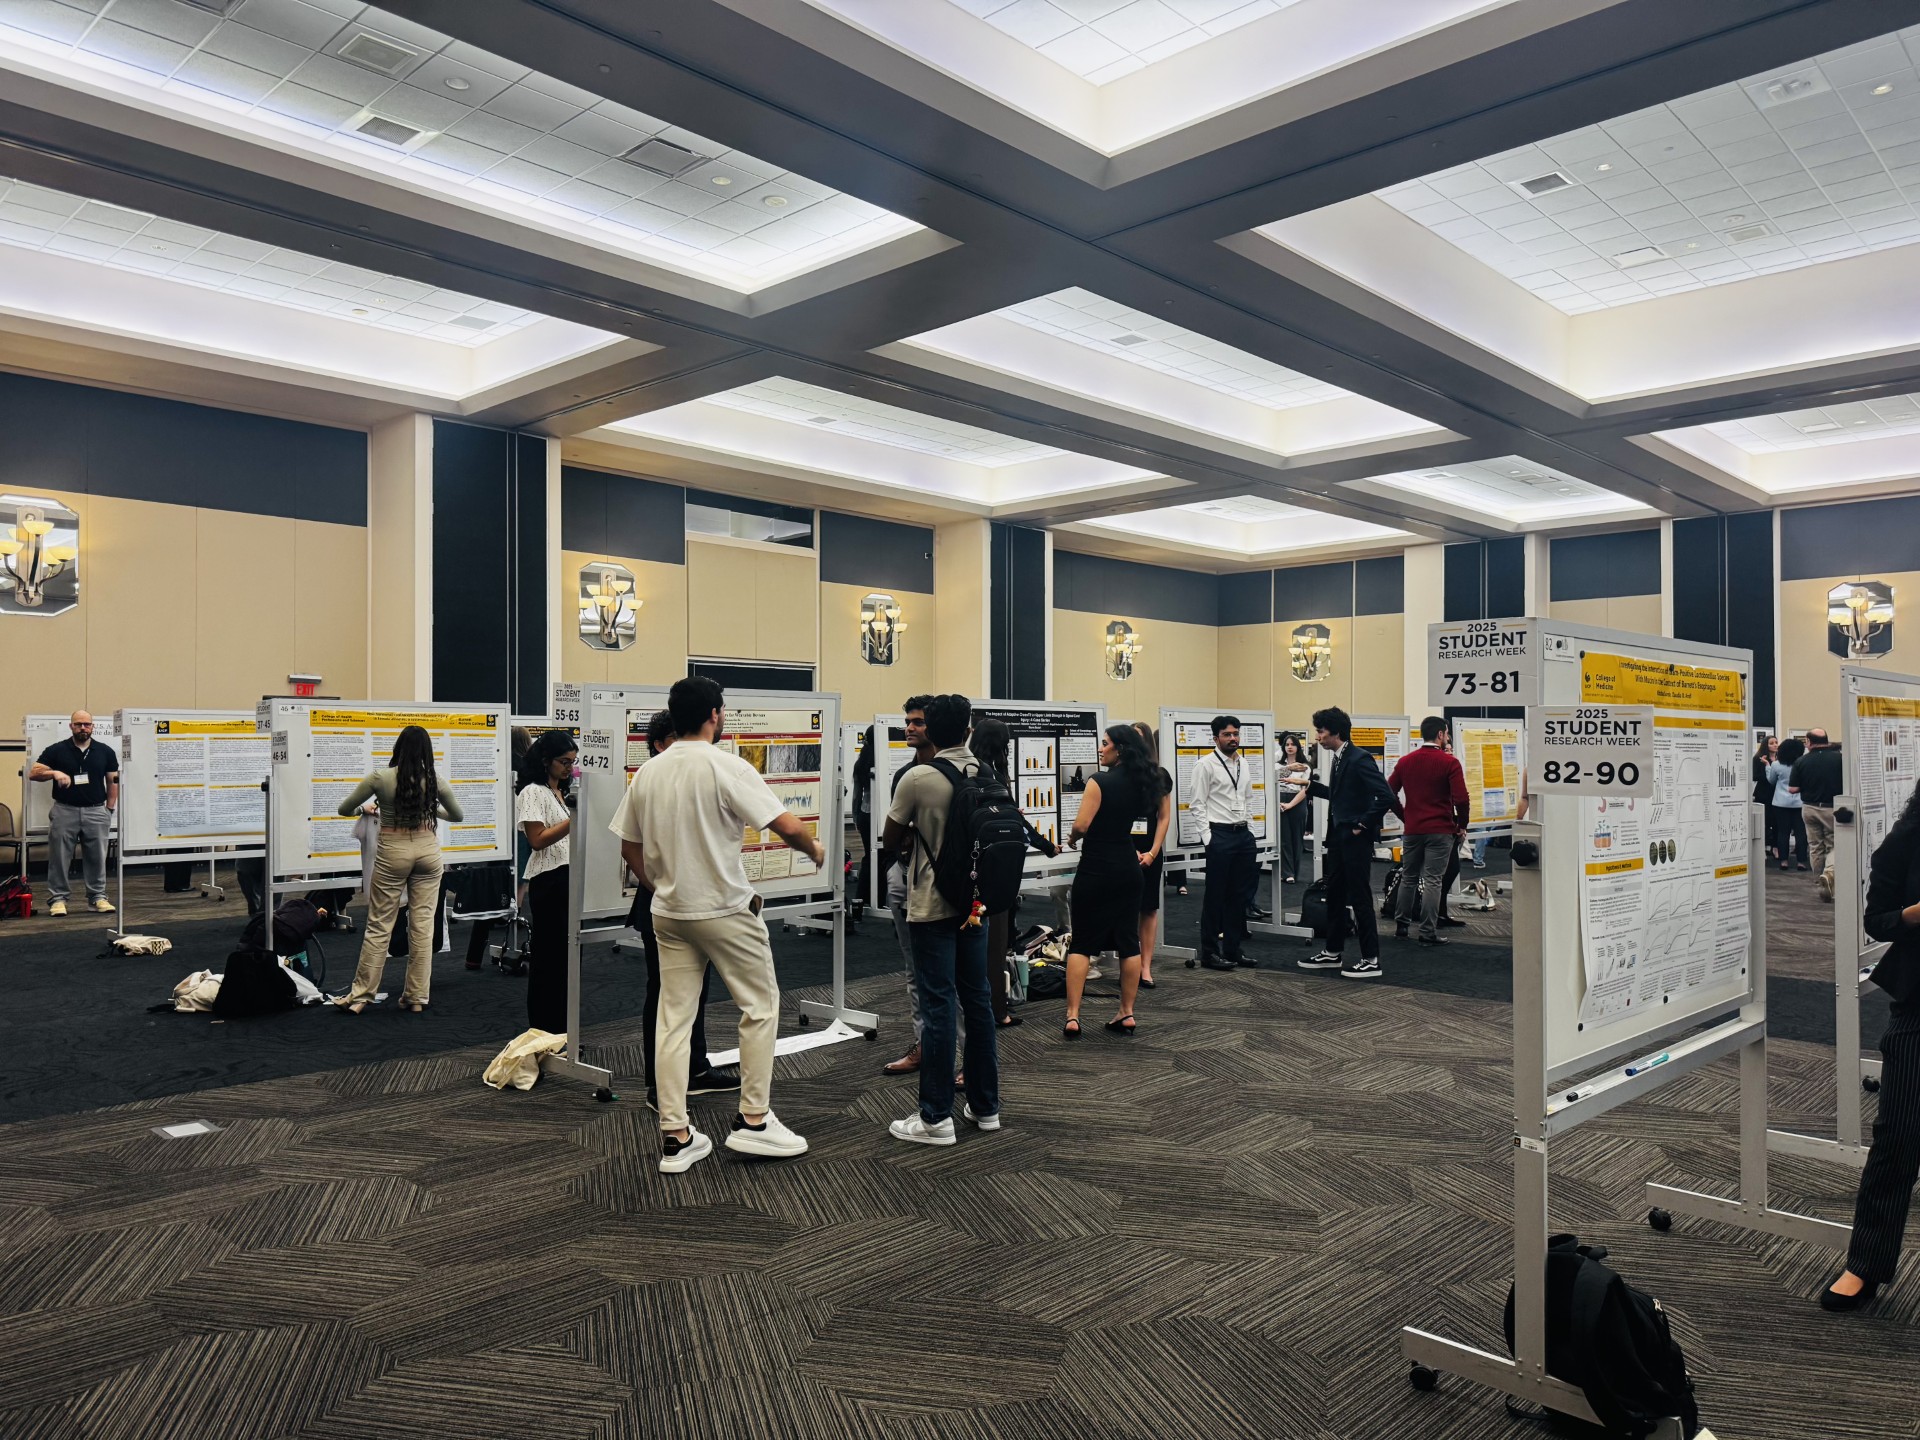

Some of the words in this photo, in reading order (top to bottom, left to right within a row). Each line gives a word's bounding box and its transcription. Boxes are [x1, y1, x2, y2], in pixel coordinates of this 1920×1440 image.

[1467, 622, 1497, 632] 2025
[1439, 631, 1527, 650] STUDENT
[1545, 637, 1553, 651] 82
[1438, 648, 1492, 659] RESEARCH
[1495, 647, 1526, 656] WEEK
[1444, 670, 1519, 695] 73-81
[1595, 674, 1611, 682] College
[296, 683, 315, 697] EXIT
[1596, 682, 1614, 690] Medicine
[555, 689, 581, 698] STUDENT
[555, 709, 580, 721] 55-63
[1576, 709, 1608, 719] 2025
[257, 720, 271, 730] 37-45
[1544, 720, 1641, 736] STUDENT
[583, 735, 610, 744] STUDENT
[1544, 737, 1602, 745] RESEARCH
[1606, 737, 1641, 746] WEEK
[272, 751, 287, 760] 46-54
[582, 755, 609, 769] 64-72
[1543, 760, 1640, 786] 82-90
